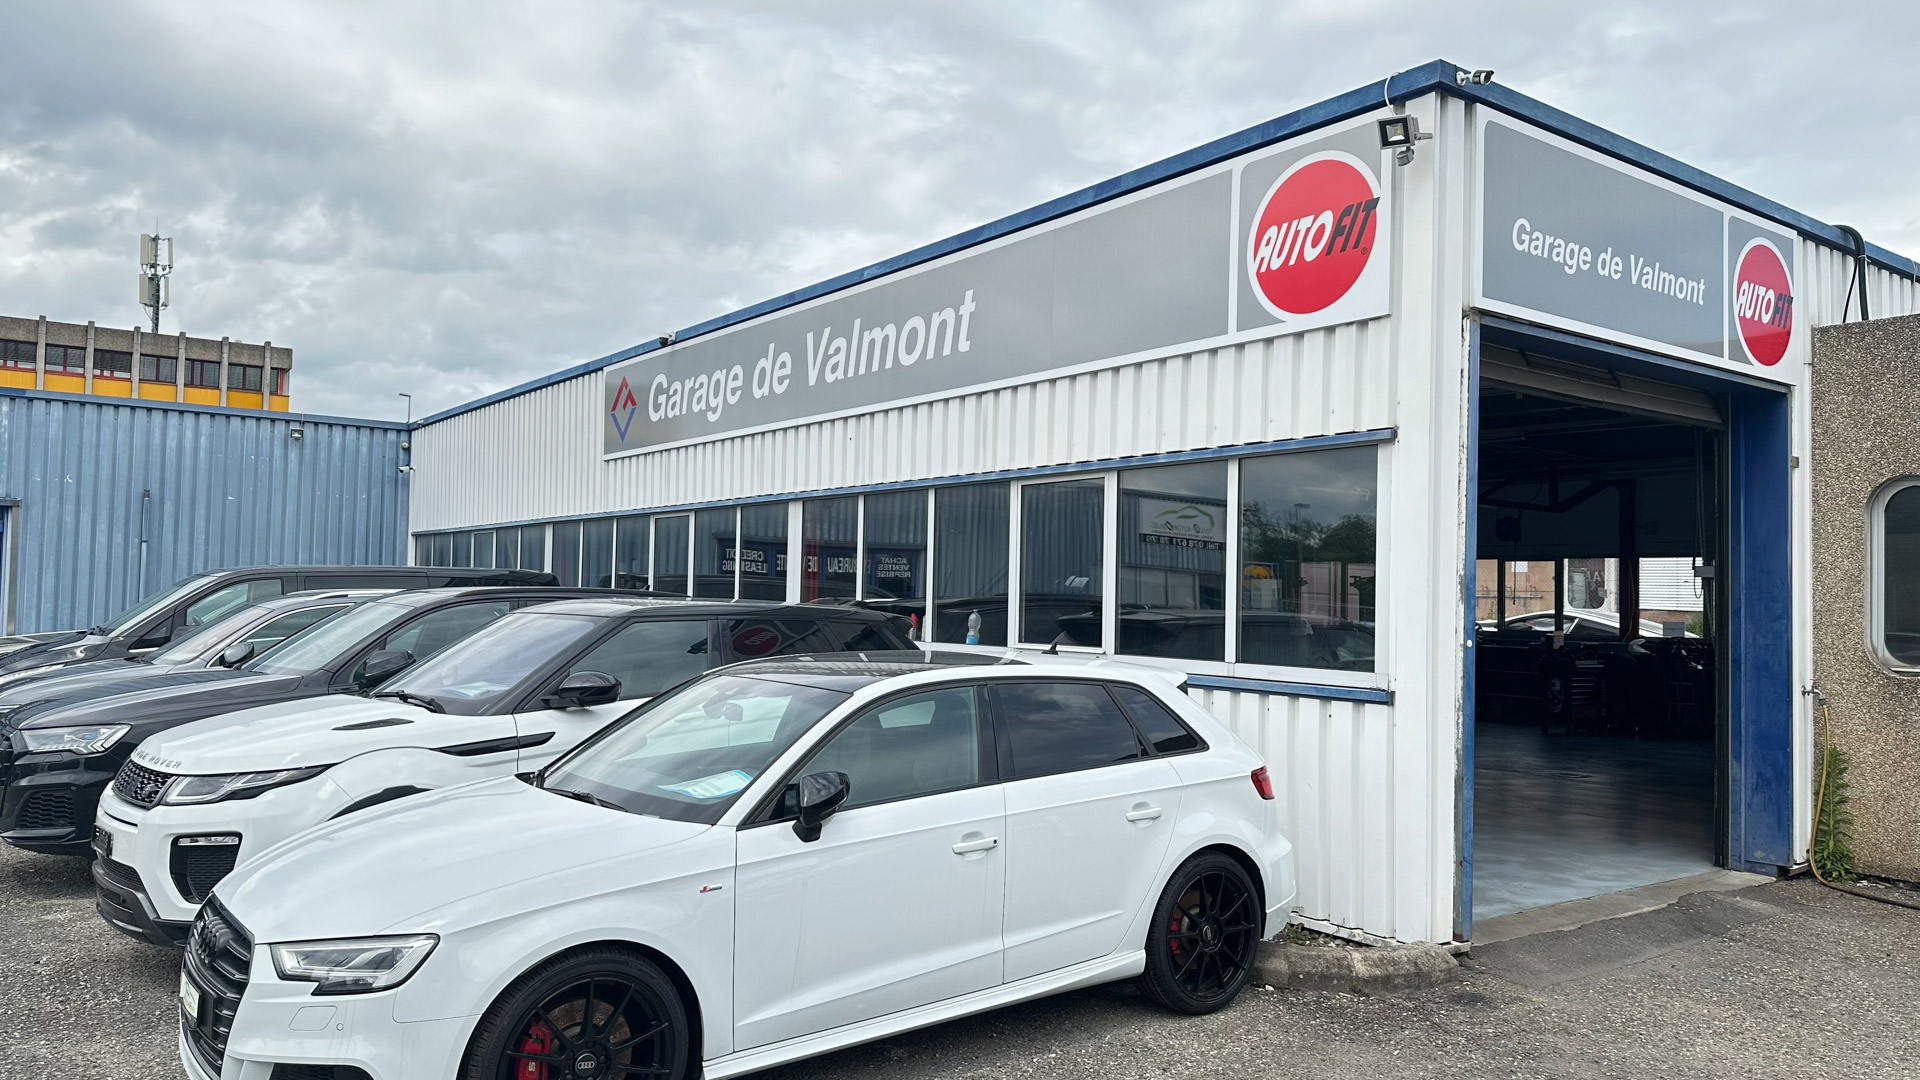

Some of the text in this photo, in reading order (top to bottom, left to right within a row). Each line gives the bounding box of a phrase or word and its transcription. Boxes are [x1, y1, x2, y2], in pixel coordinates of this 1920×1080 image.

[1253, 196, 1381, 274] AUTOFIT
[1511, 217, 1706, 306] Garage de Valmont
[1736, 279, 1794, 330] AUTOFIT
[648, 289, 977, 423] Garage de Valmont
